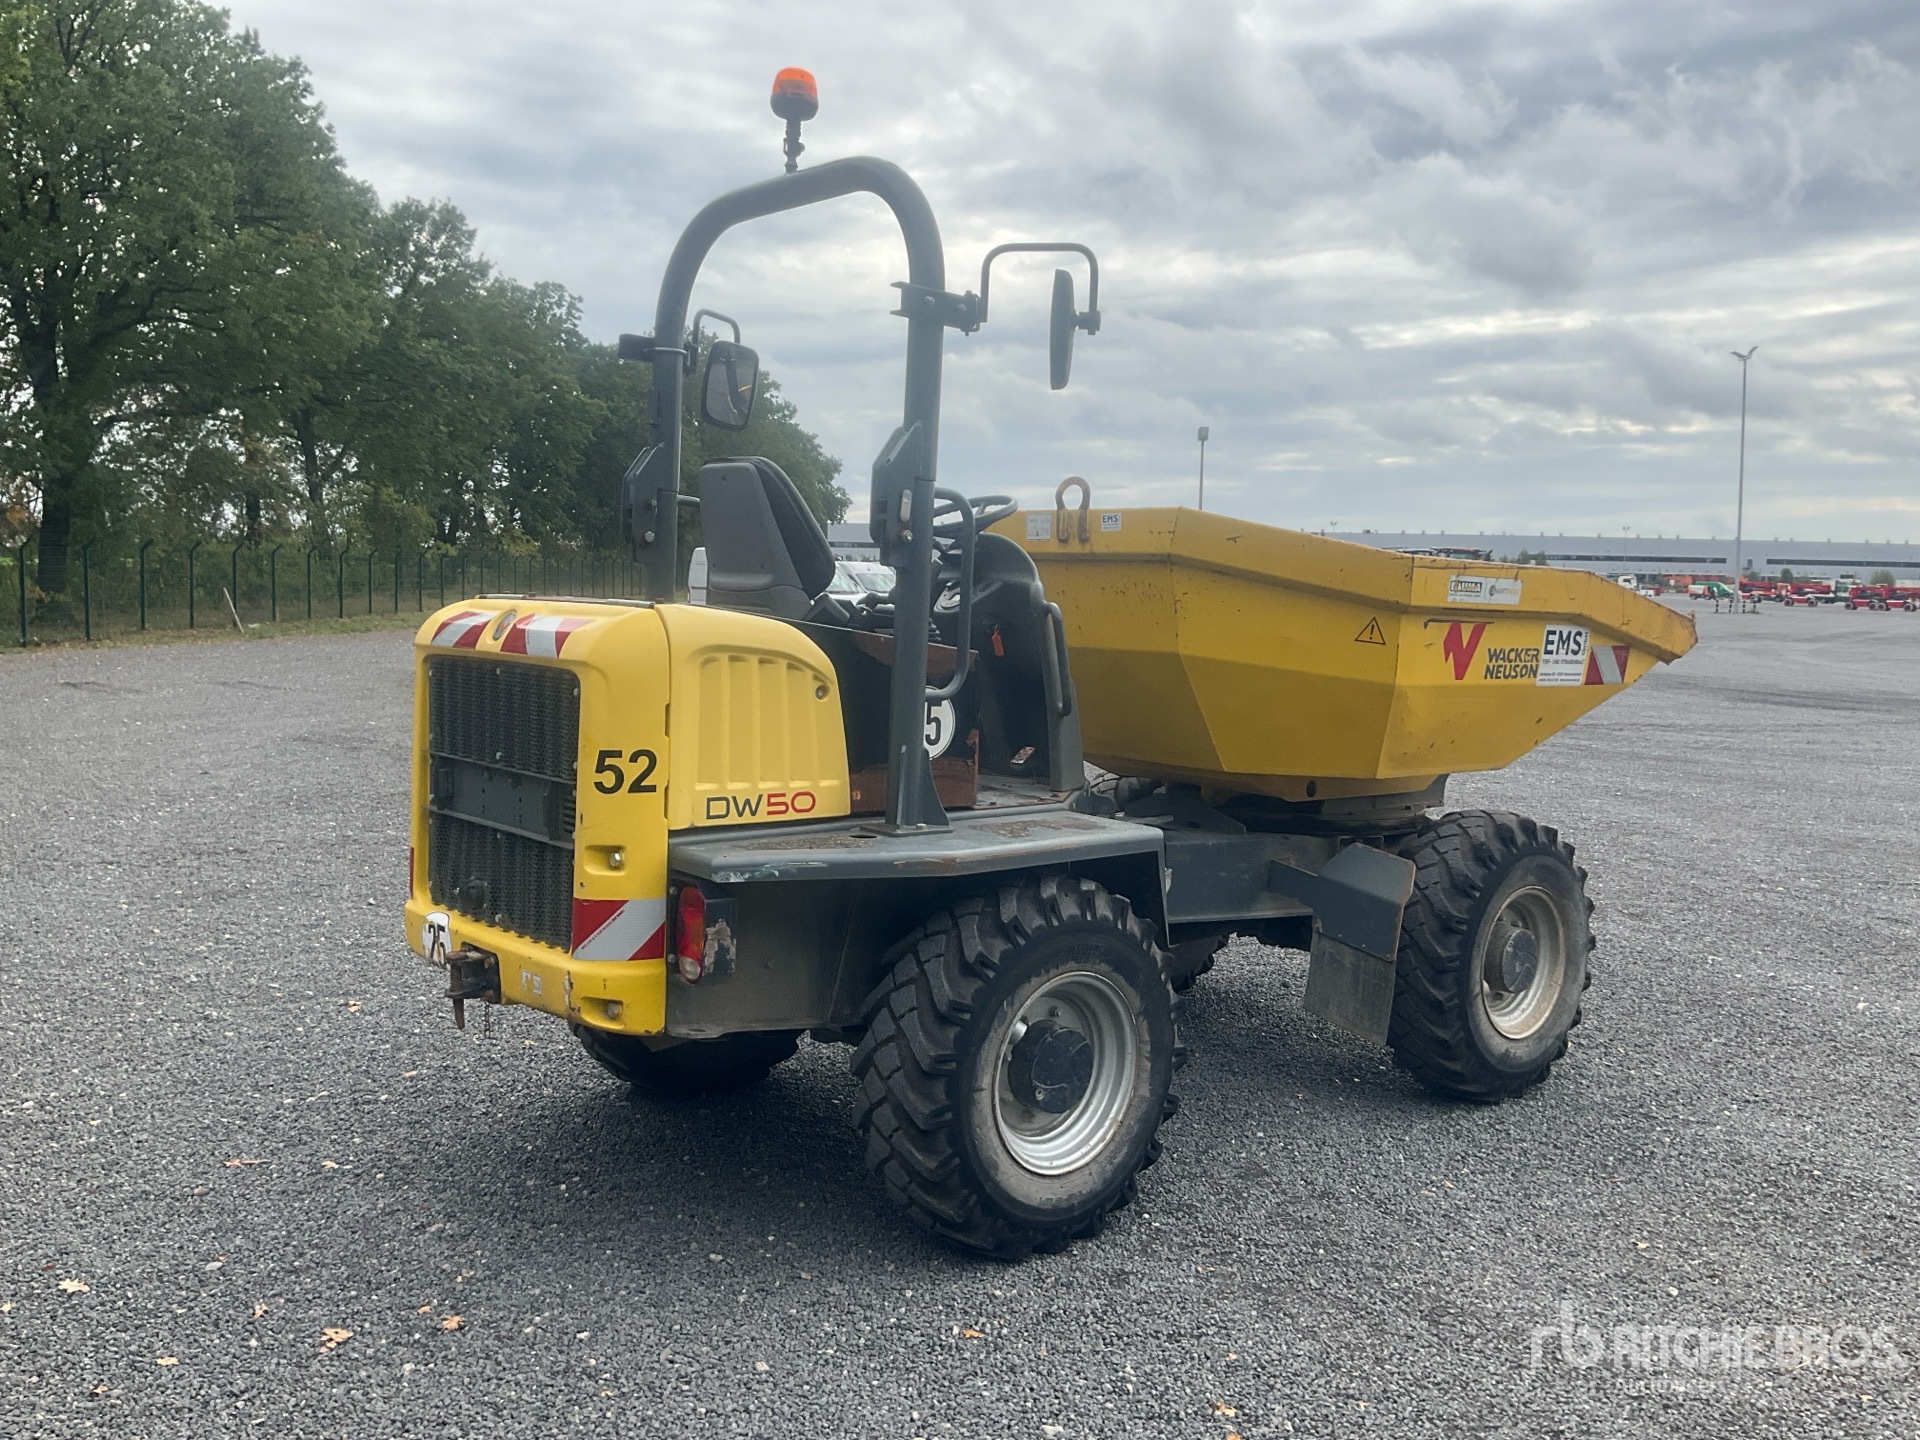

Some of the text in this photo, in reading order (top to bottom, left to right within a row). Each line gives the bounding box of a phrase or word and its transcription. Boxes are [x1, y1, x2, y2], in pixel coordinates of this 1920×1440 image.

[1102, 514, 1119, 523] EMS
[1543, 629, 1583, 656] EMS
[1487, 647, 1540, 663] WACKER
[1484, 663, 1539, 680] NEUSON
[594, 749, 657, 795] 52
[705, 791, 816, 820] DW50
